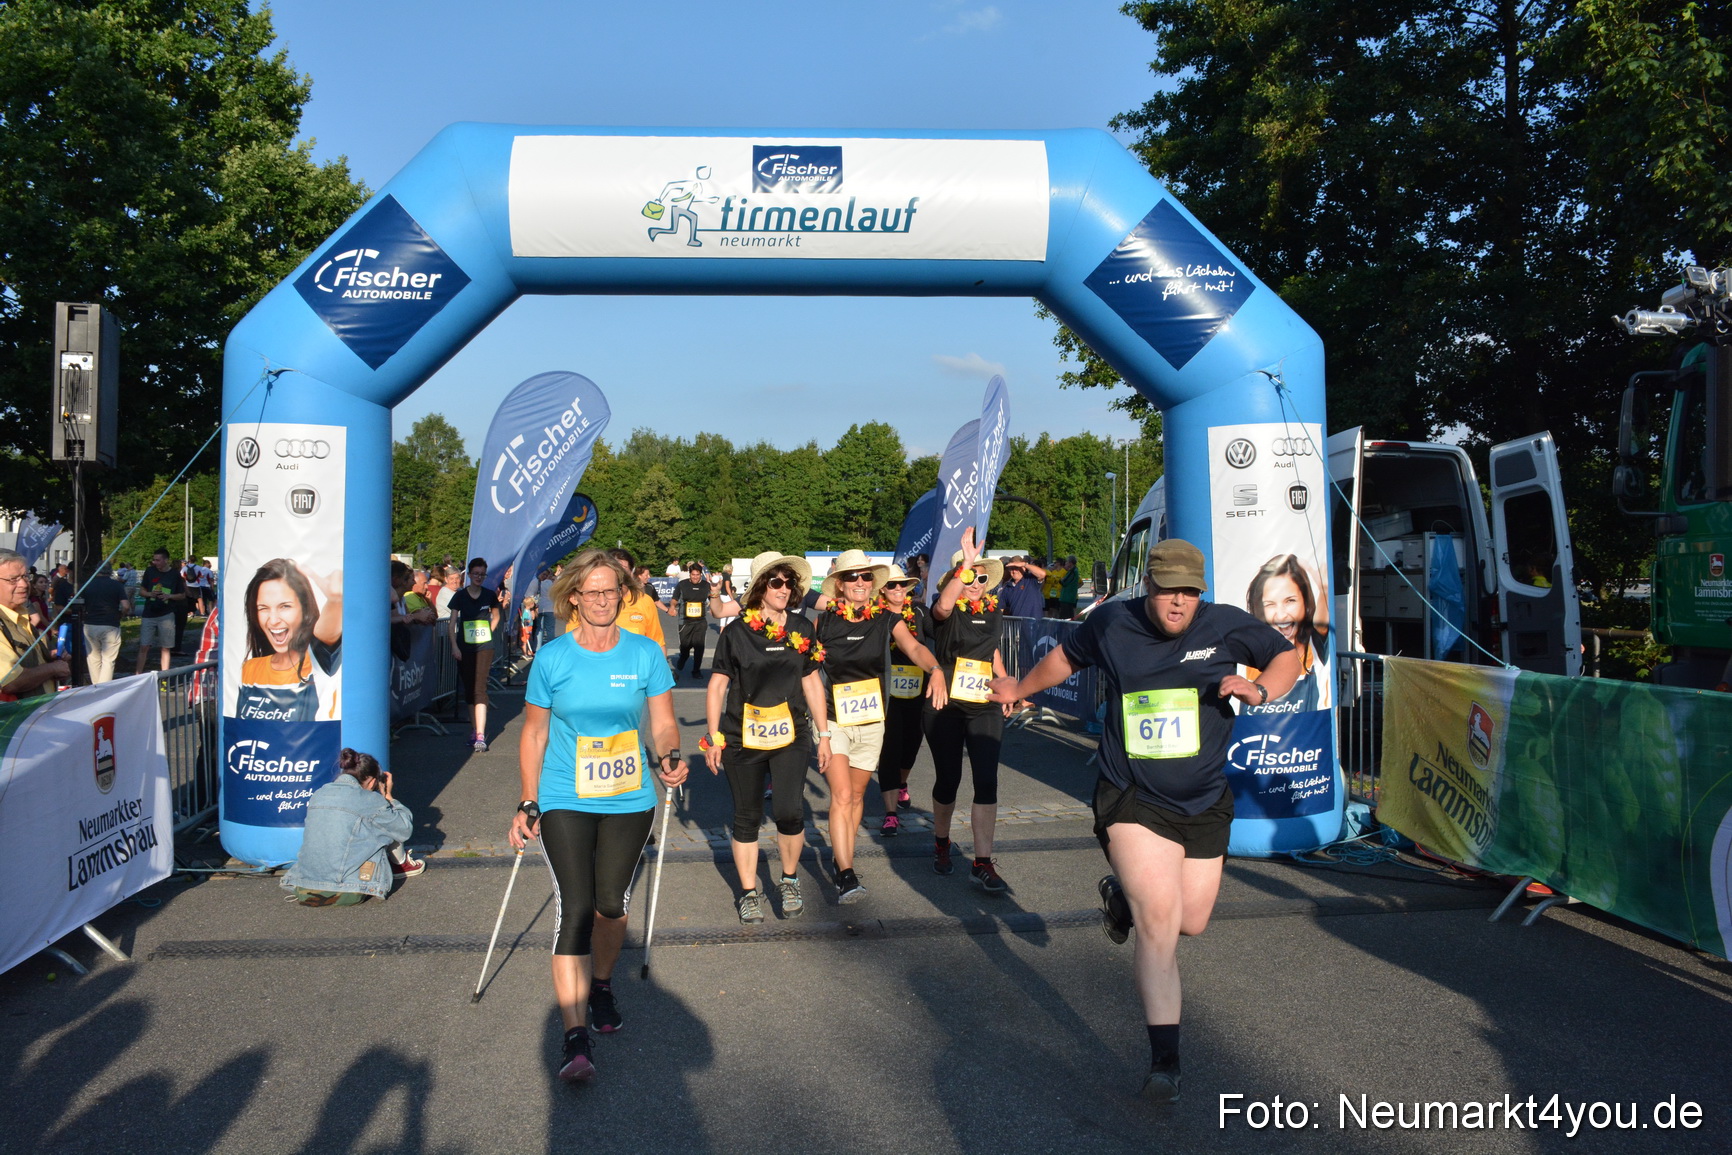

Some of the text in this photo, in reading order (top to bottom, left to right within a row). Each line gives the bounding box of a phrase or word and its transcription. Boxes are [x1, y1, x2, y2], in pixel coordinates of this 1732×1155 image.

[772, 163, 837, 175] Fischer
[720, 195, 919, 232] firmenlauf
[720, 234, 801, 247] neumarkt
[334, 267, 442, 288] Fischer
[1205, 281, 1233, 292] mit!
[342, 290, 432, 300] AUTOMOBILE
[508, 397, 582, 497] Fischer
[532, 417, 590, 496] AUTOMOBILE
[293, 494, 313, 508] FIAT
[1291, 490, 1306, 505] FIAT
[1226, 510, 1267, 518] SEAT
[469, 629, 486, 637] 766
[893, 678, 919, 689] 1254
[841, 696, 878, 714] 1244
[245, 706, 297, 722] Fischer
[748, 722, 789, 738] 1246
[1139, 716, 1181, 740] 671
[239, 754, 320, 773] Fischer
[1246, 747, 1322, 766] Fischer
[584, 756, 636, 780] 1088
[1254, 763, 1318, 775] AUTOMOBILE
[244, 773, 312, 782] AUTOMOBILE
[1288, 780, 1303, 790] das
[256, 791, 273, 801] und
[275, 790, 292, 799] das
[79, 798, 142, 844] Neumarkter
